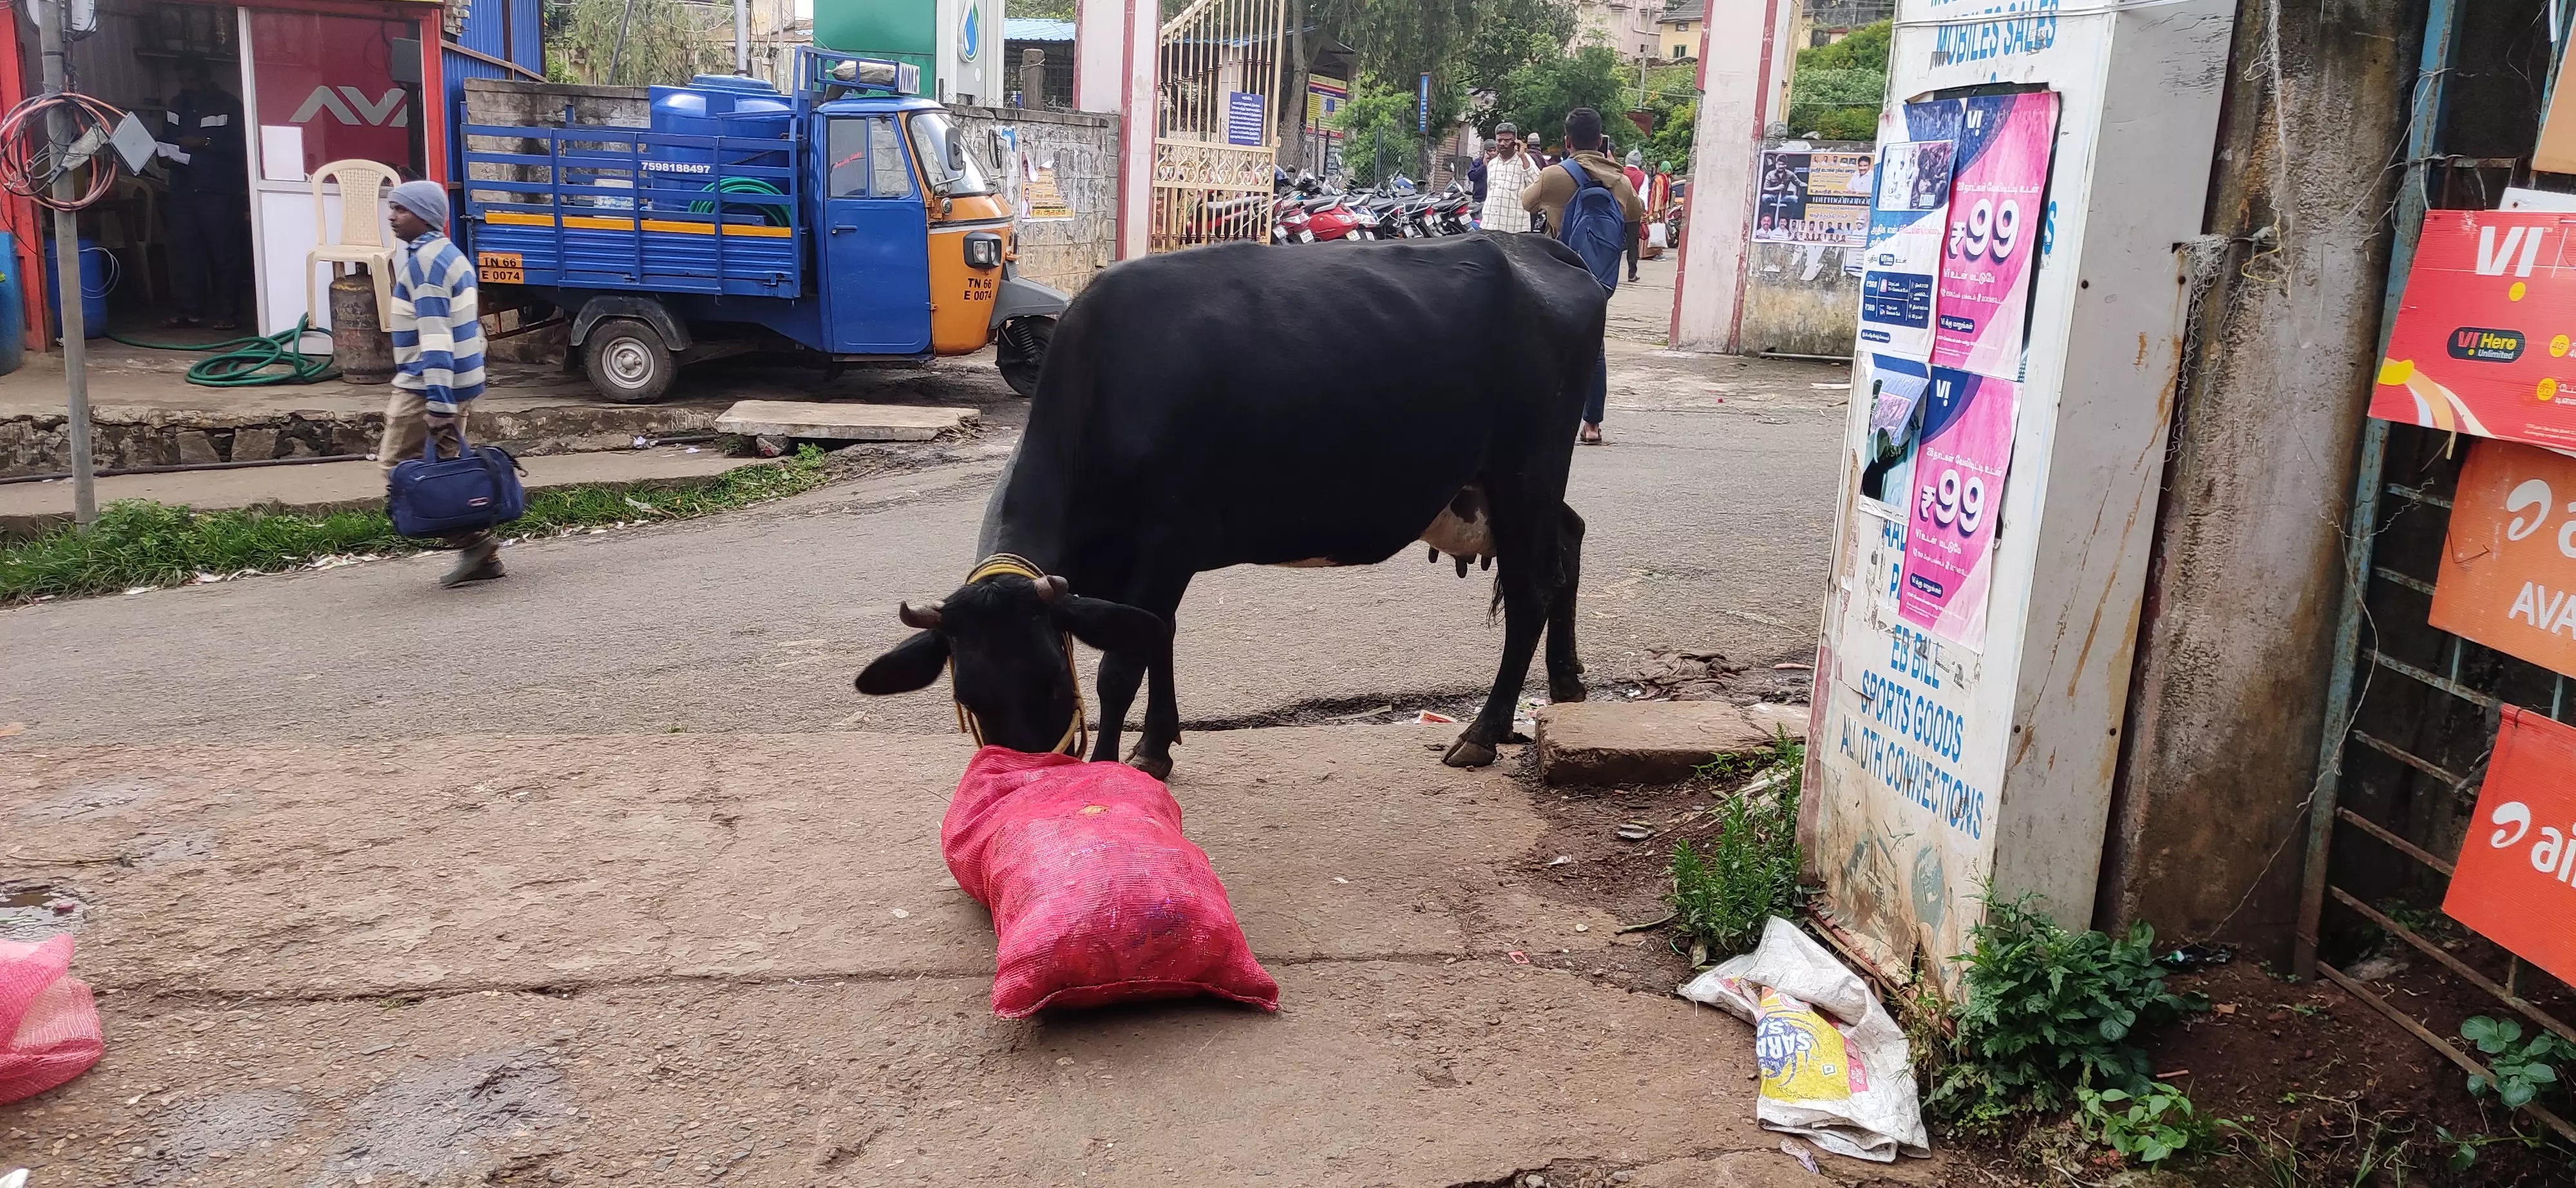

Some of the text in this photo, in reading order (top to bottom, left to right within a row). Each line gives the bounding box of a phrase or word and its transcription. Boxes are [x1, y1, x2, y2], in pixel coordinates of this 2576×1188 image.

[1934, 0, 2059, 67] MOBILES SALES
[902, 66, 918, 92] NMS
[641, 162, 711, 174] 7598188497
[1949, 198, 2020, 259] ₹99
[485, 258, 516, 268] TN 66
[482, 271, 520, 281] E 0074
[968, 278, 992, 289] TN 66
[964, 290, 992, 300] E 0074
[2480, 333, 2517, 350] Hero
[2478, 349, 2514, 360] Unlimited
[1920, 469, 1985, 533] ₹99
[1891, 624, 1940, 690] EB BILL
[1861, 669, 1964, 763] SPORTS GOODS
[1886, 742, 1984, 840] CONNECTIONS
